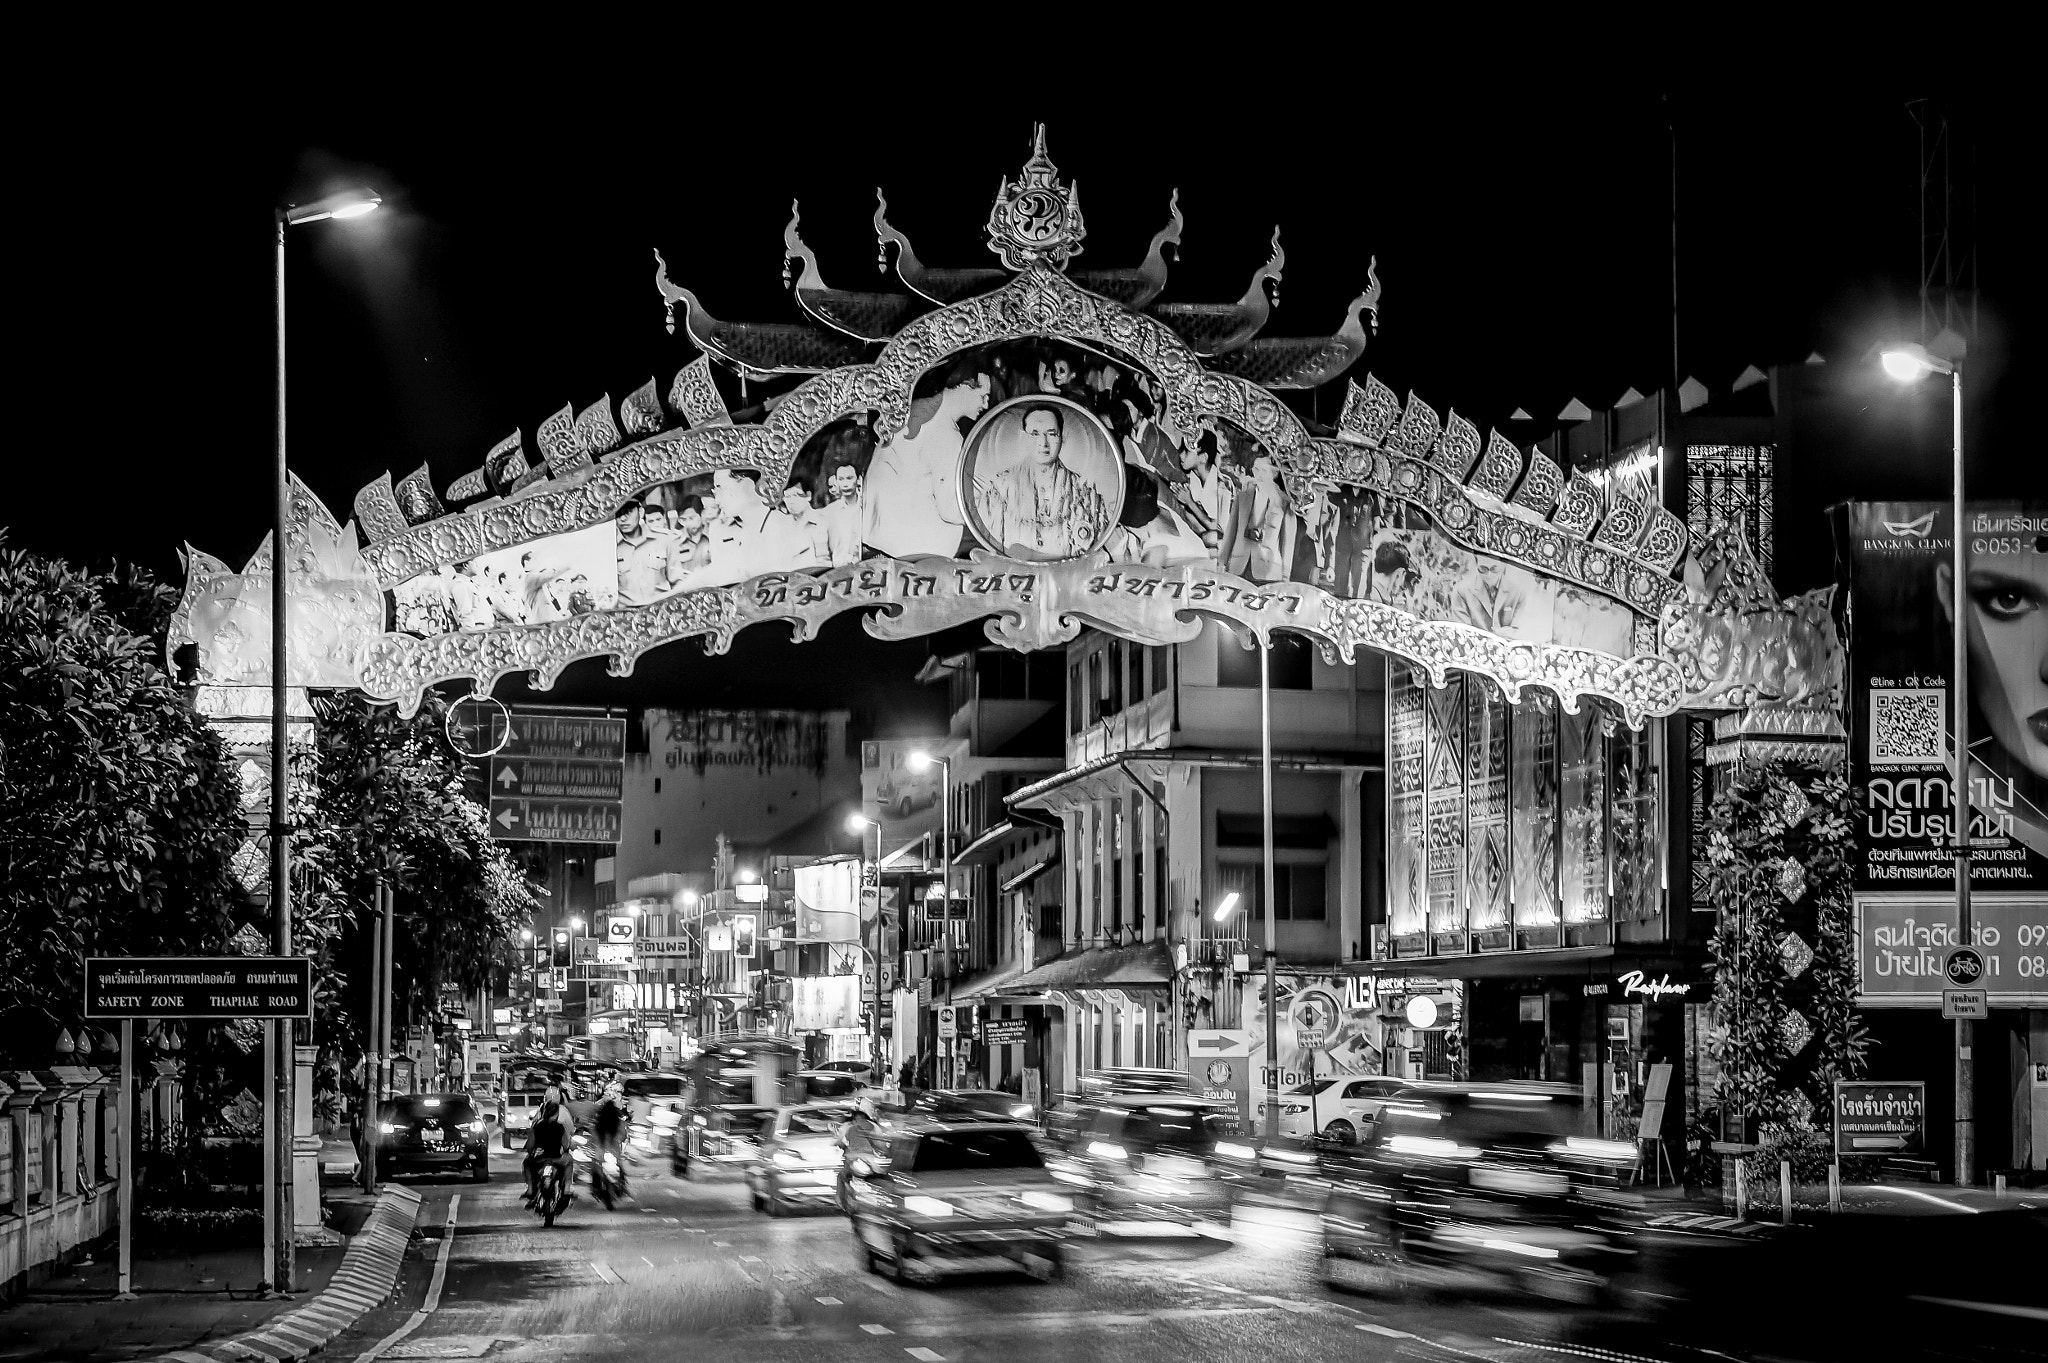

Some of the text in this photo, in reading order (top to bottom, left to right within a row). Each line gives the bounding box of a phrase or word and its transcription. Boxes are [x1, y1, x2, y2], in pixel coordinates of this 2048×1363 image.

[1864, 539, 1955, 550] BANGKOK CLINIC
[1088, 572, 1302, 614] มหาราชา
[1923, 675, 1946, 687] Code
[529, 828, 611, 840] NIGHT BAZAAR
[1344, 975, 1377, 1009] ALEX
[98, 996, 298, 1007] SAFETY ZONE THAPHAE ROAD
[1839, 1092, 1922, 1117] โรงรับจำนำ
